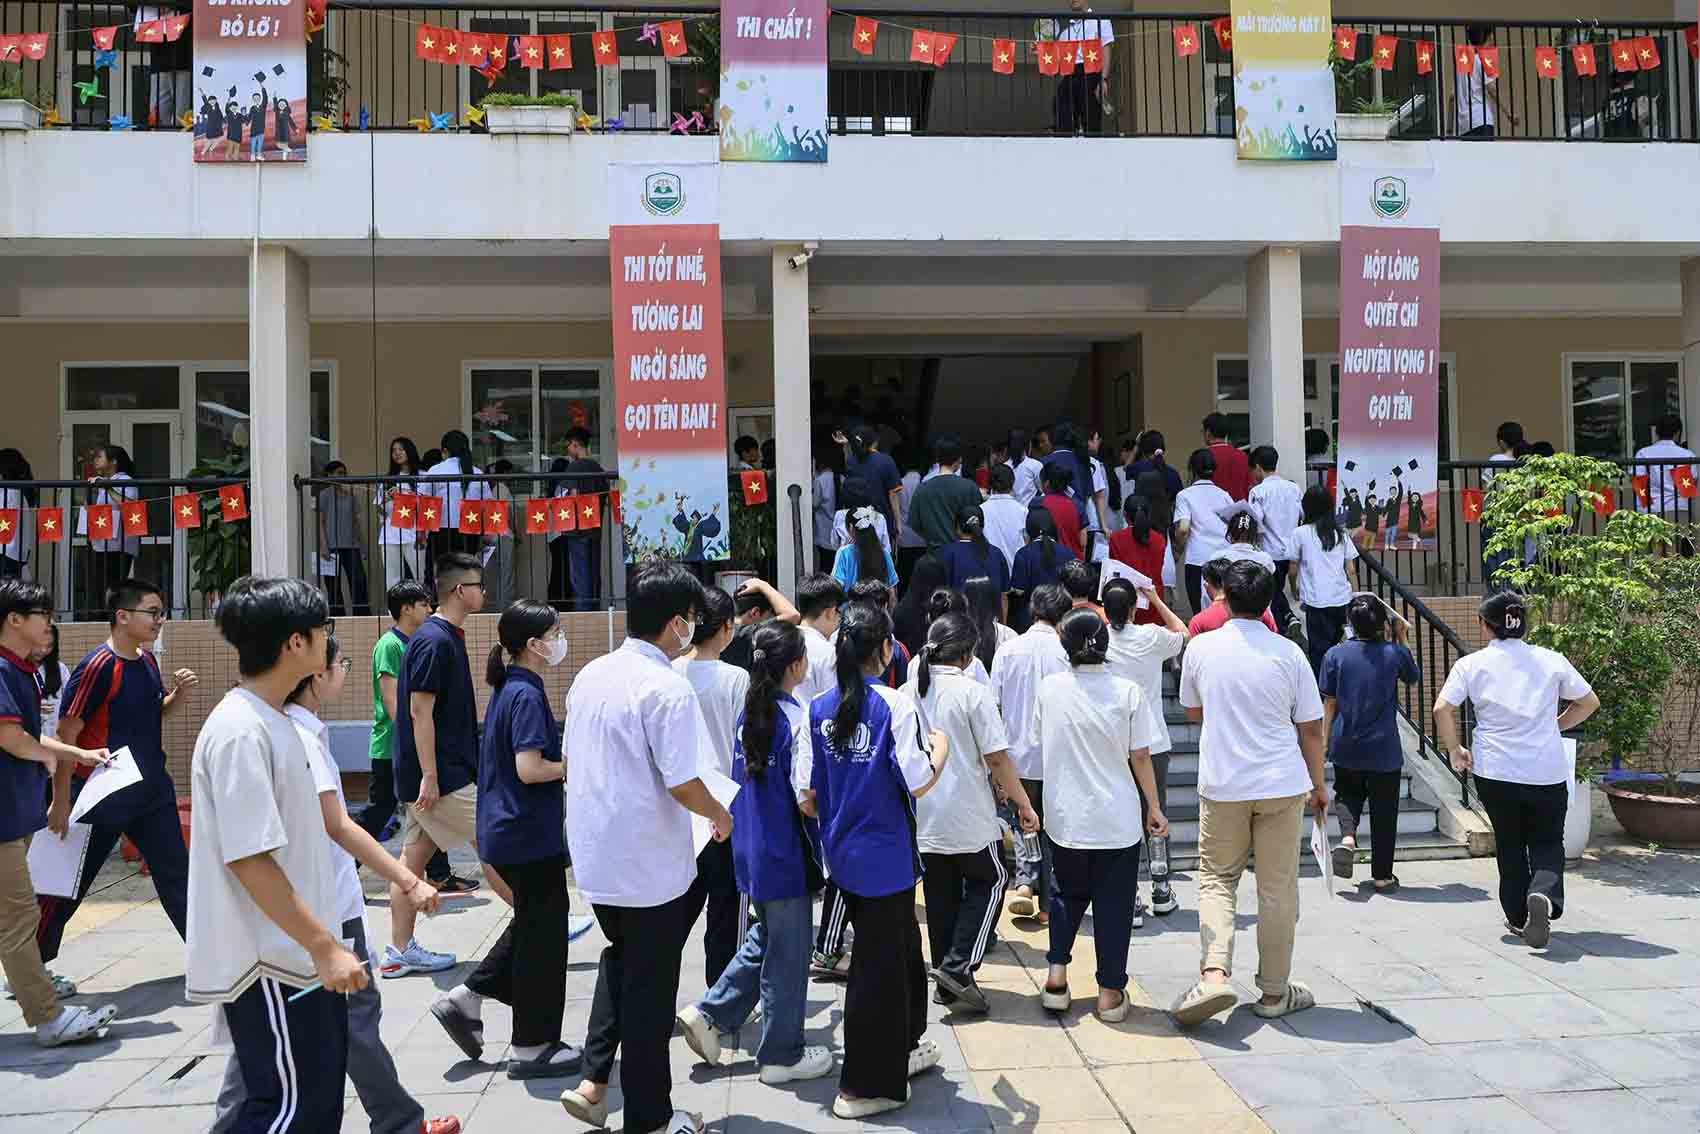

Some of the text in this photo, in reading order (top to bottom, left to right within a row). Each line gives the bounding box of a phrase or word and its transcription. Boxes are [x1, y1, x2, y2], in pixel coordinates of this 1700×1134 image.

[220, 13, 280, 37] BỎ LỠ !
[736, 7, 812, 40] THI CHẤT !
[623, 242, 707, 287] THI TỐT NHÉ,
[1362, 248, 1419, 287] MỘT LÒNG
[631, 298, 703, 332] TƯƠNG LAI
[1364, 289, 1419, 329] QUYẾT CHÍ
[630, 345, 707, 381] NGỜI SÁNG
[1343, 341, 1392, 381] NGUYỆN
[1393, 348, 1425, 382] VỌNG
[624, 396, 717, 438] GỌI TÊN BẠN !
[1368, 387, 1413, 428] GỌI TÊN
